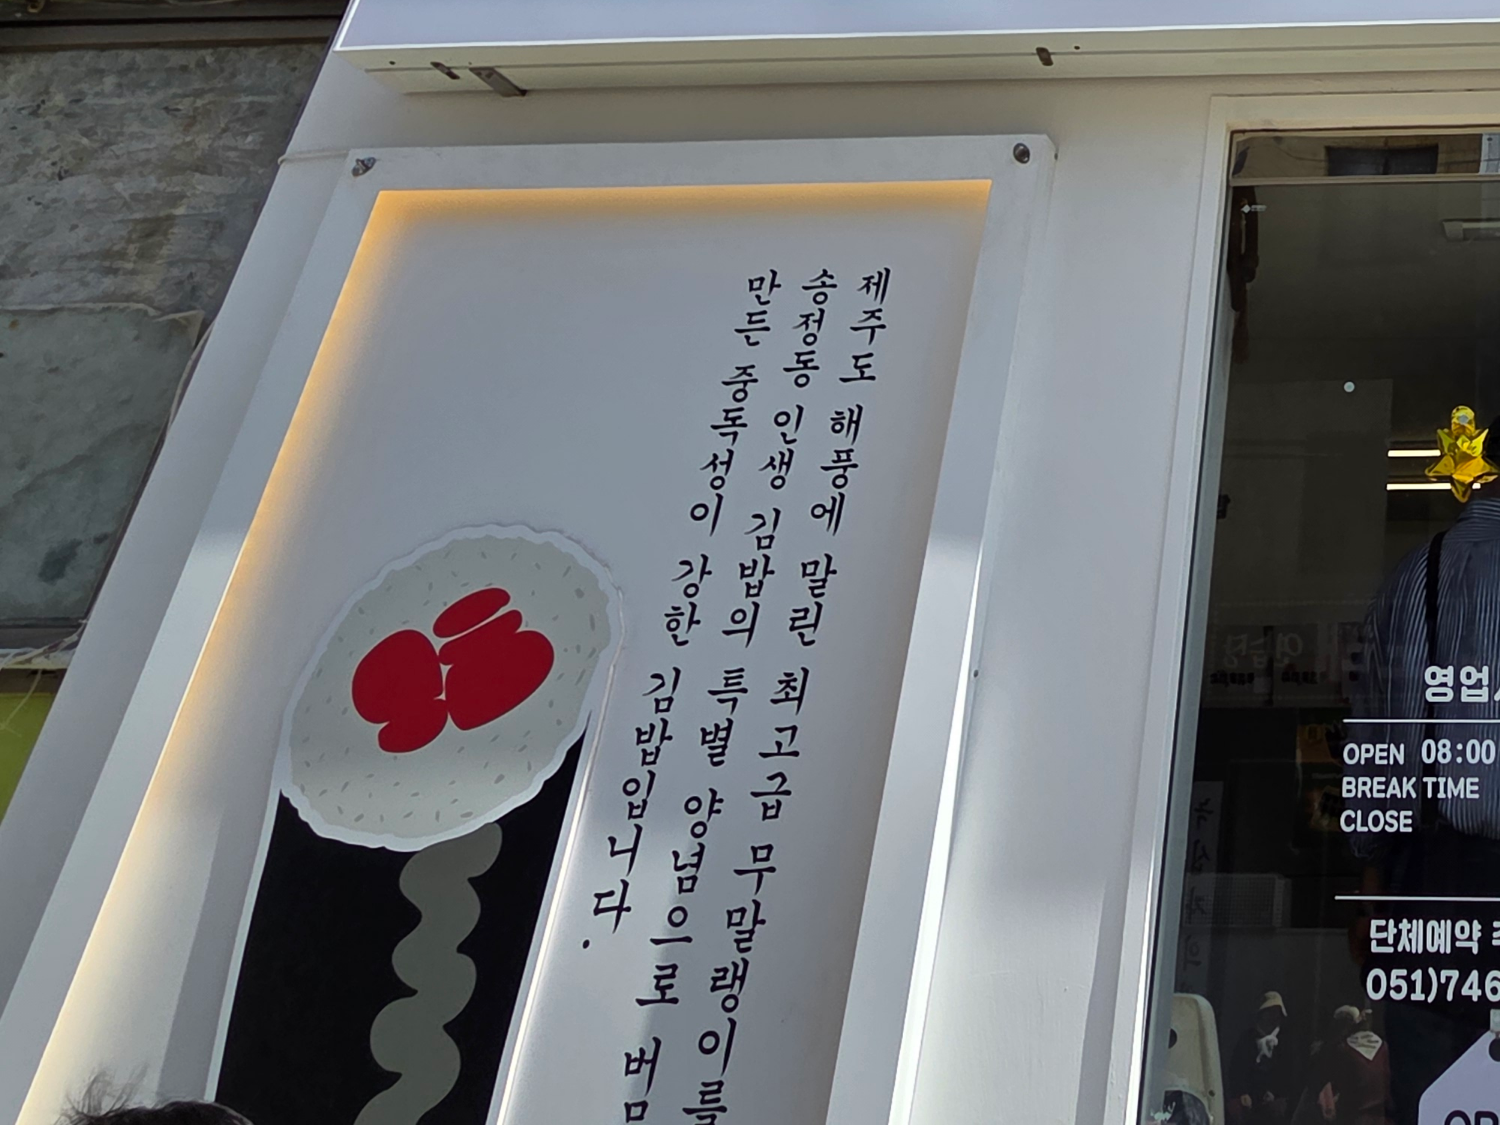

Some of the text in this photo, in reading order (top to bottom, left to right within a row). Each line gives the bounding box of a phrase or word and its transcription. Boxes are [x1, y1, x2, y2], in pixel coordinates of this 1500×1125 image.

[782, 268, 838, 388] 송정동
[838, 267, 891, 383] 제주도
[758, 404, 804, 490] 인생
[810, 404, 864, 537] 해풍에
[582, 269, 782, 949] 만든 중독성이 강한 김밥입니다.
[721, 507, 782, 648] 김밥의
[788, 553, 838, 647] 말린
[700, 667, 749, 767] 특별
[750, 666, 810, 821] 최고급
[1343, 738, 1497, 765] OPEN 08:00
[1340, 809, 1413, 833] CLOSE
[1341, 776, 1417, 799] BREAK
[1423, 777, 1480, 799] TIME
[635, 787, 724, 1007] 양념으로
[1370, 919, 1482, 954] 단체예약
